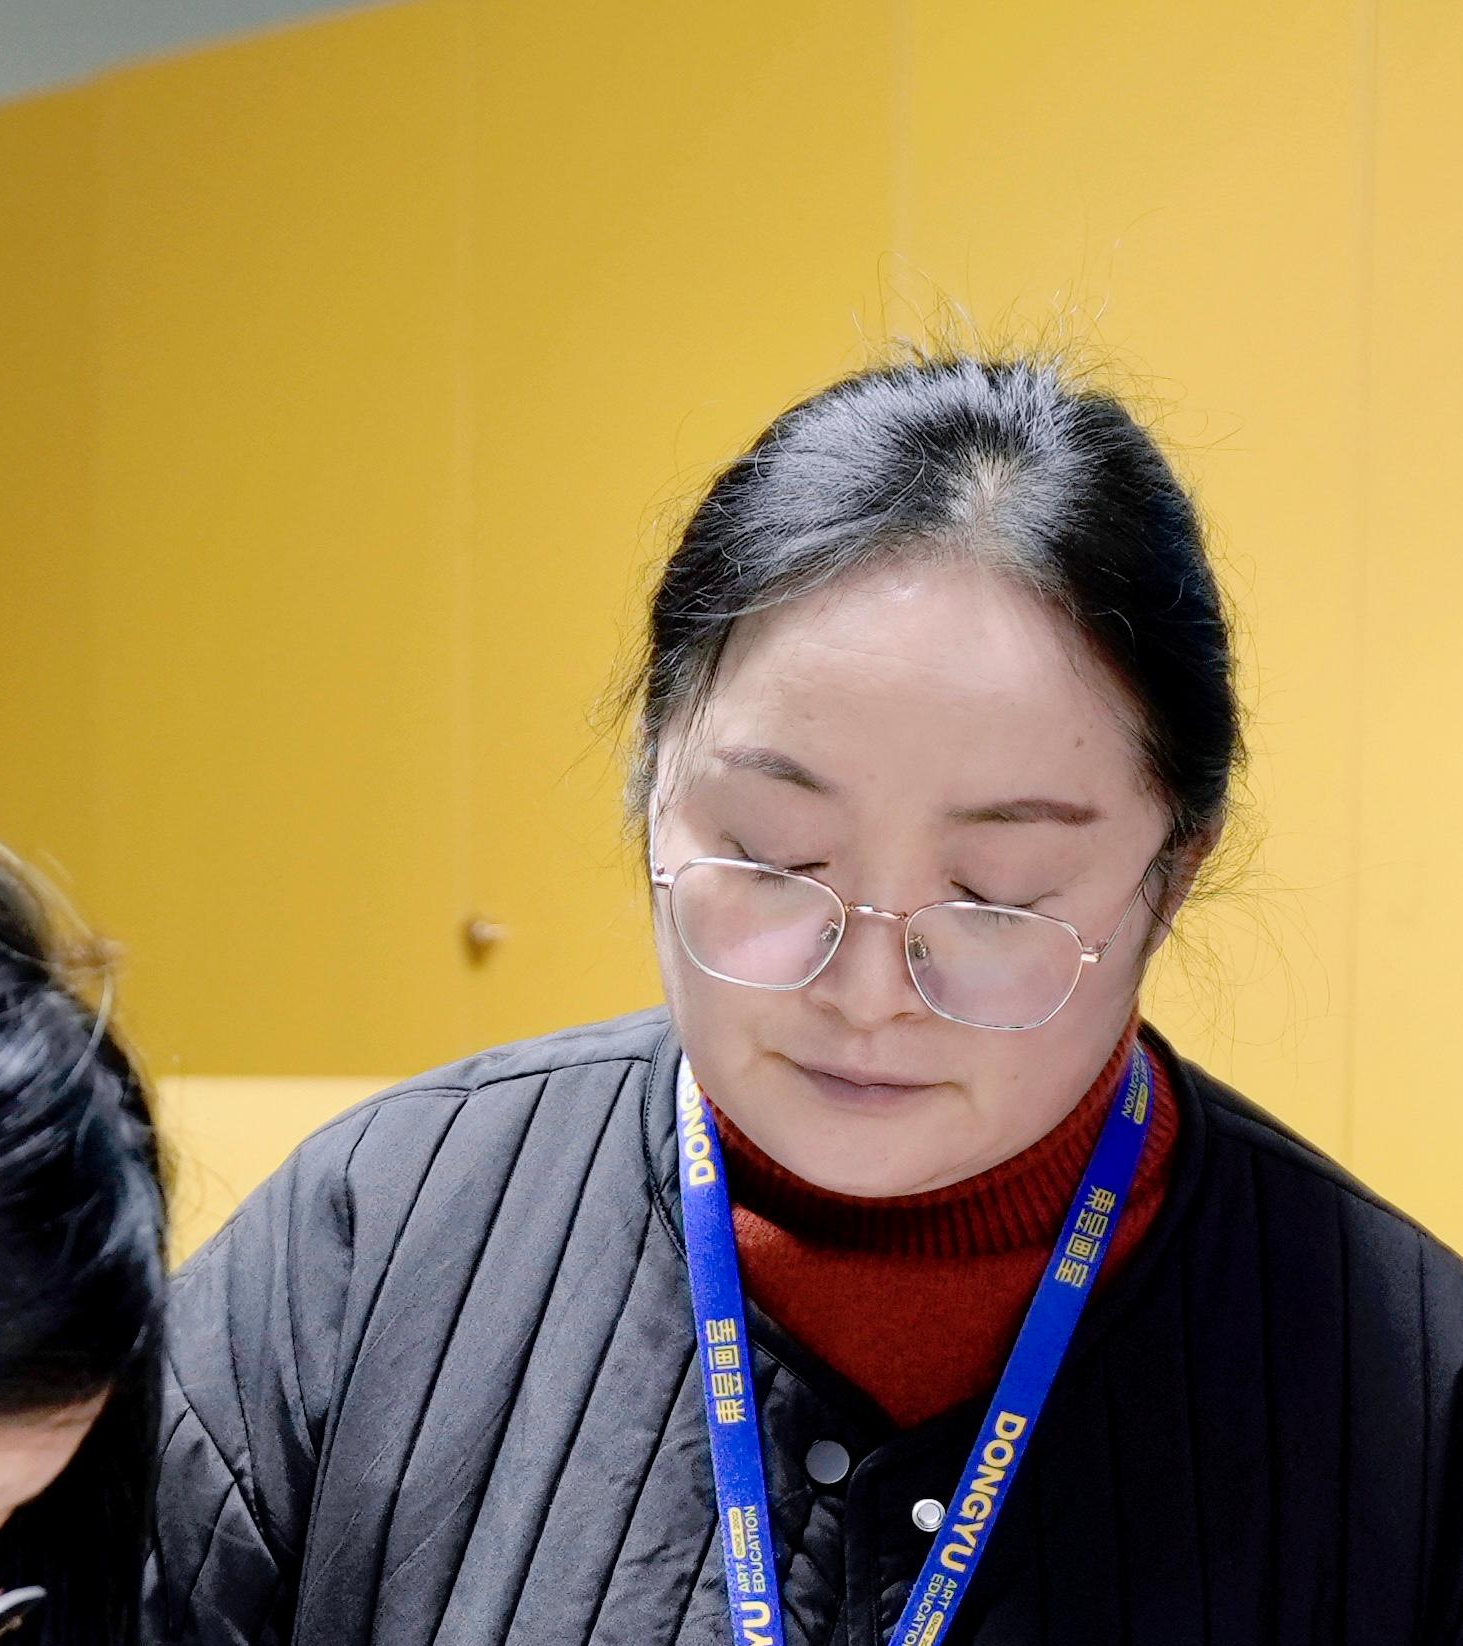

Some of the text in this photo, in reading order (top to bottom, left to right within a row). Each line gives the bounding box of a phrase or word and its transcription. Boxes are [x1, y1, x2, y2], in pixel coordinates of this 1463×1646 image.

[940, 1410, 1027, 1573] DONGYU
[736, 1561, 751, 1593] ART
[744, 1505, 766, 1592] EDUCATION
[938, 1578, 958, 1610] ART
